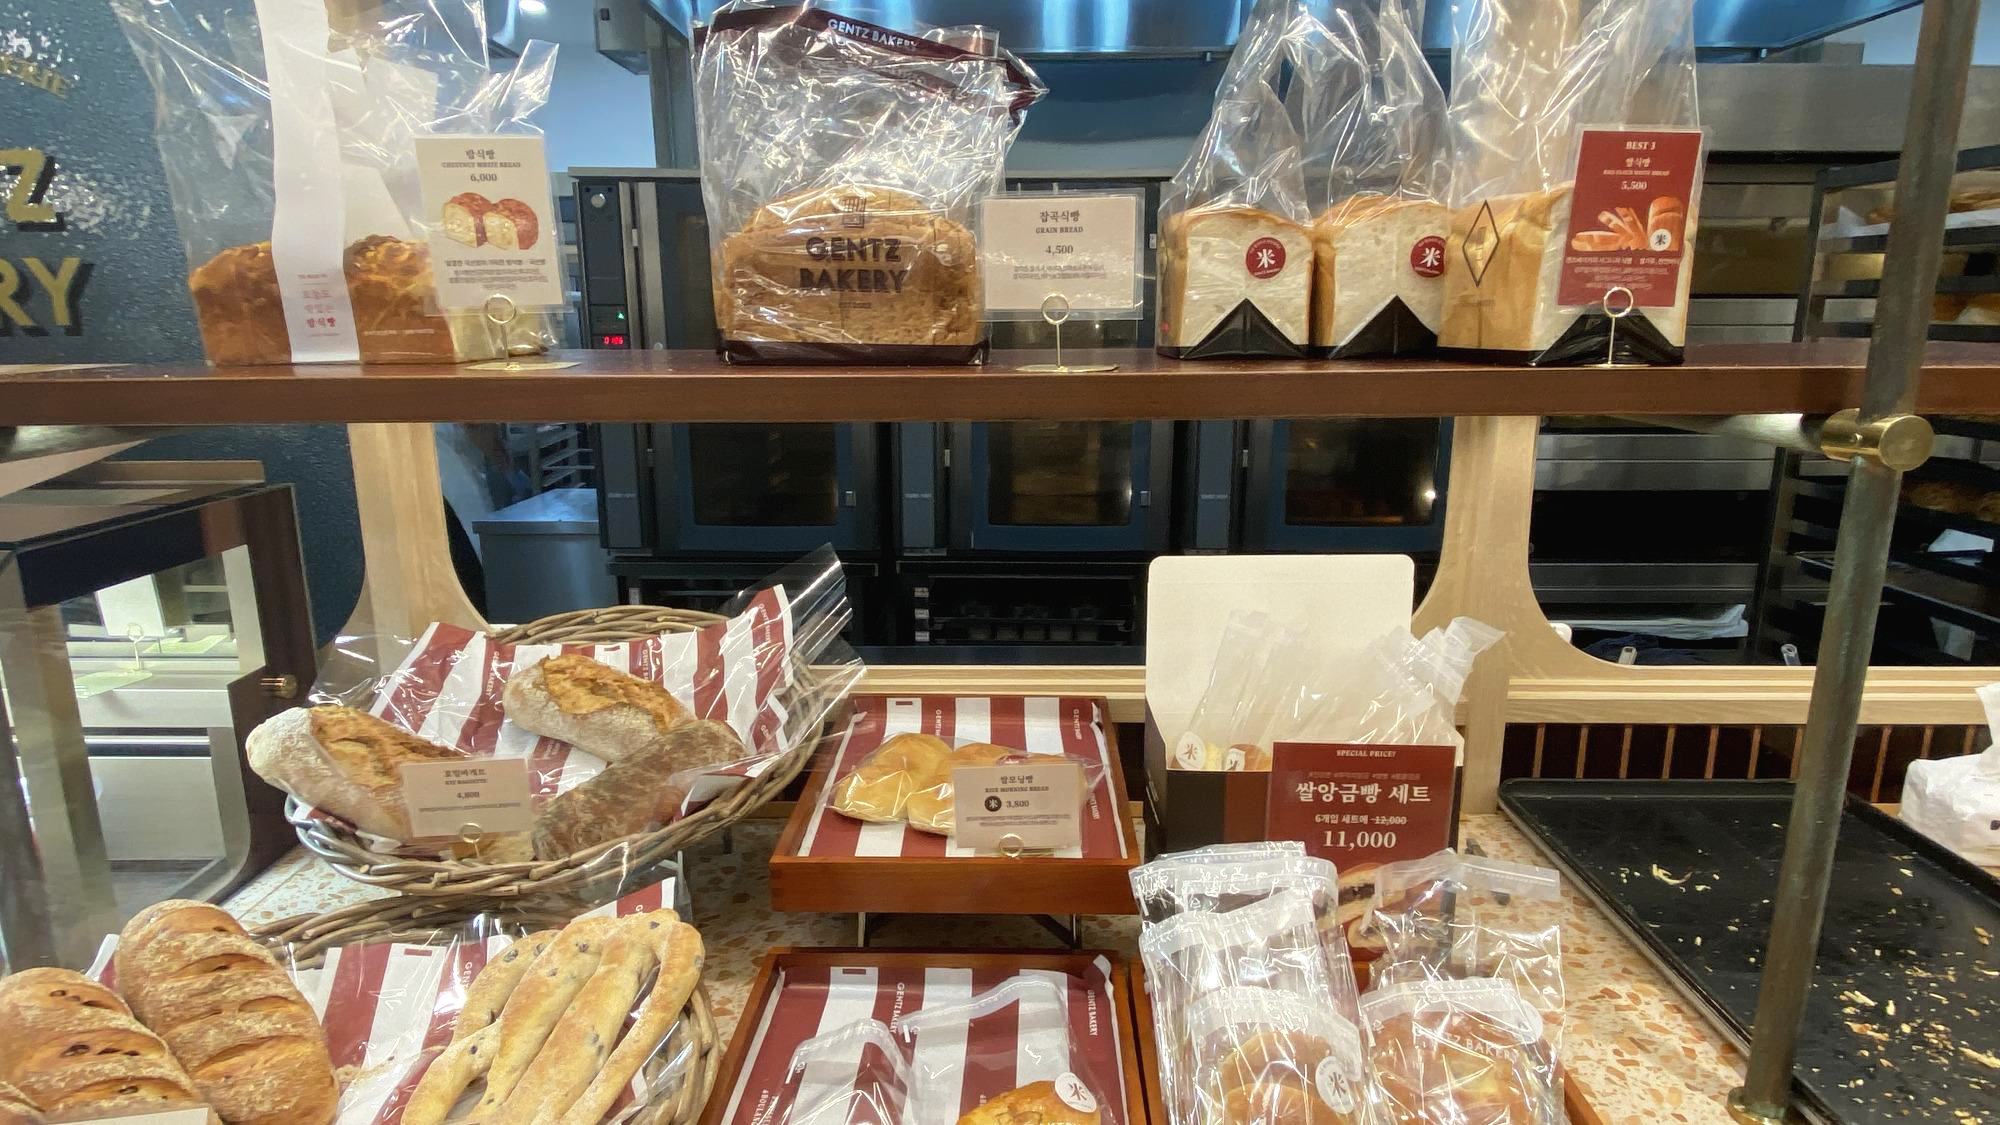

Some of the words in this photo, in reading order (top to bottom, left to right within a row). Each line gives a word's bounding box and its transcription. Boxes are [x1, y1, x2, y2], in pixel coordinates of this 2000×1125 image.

[827, 18, 870, 39] GENTZ
[1626, 141, 1649, 150] BEST
[470, 173, 498, 182] 6,000
[1621, 181, 1648, 190] 5,500
[1039, 210, 1081, 223] 잡곡식빵
[1035, 227, 1058, 235] GRAIN
[1059, 226, 1084, 235] BREAD
[805, 237, 902, 262] GENTZ
[1045, 245, 1075, 256] 4,500
[799, 267, 908, 294] BAKERY
[1336, 749, 1369, 757] SPECIAL
[1296, 781, 1382, 805] 쌀앙금빵
[1388, 783, 1431, 805] 세트
[1006, 800, 1030, 809] 3,800
[1315, 814, 1339, 825] 6개입
[1341, 814, 1369, 825] 세트에
[1322, 830, 1397, 851] 11,000
[894, 982, 905, 1009] GENTZ
[1087, 989, 1097, 1012] GENTZ
[889, 1009, 901, 1034] BAKERY
[1088, 1011, 1099, 1036] BAKERY
